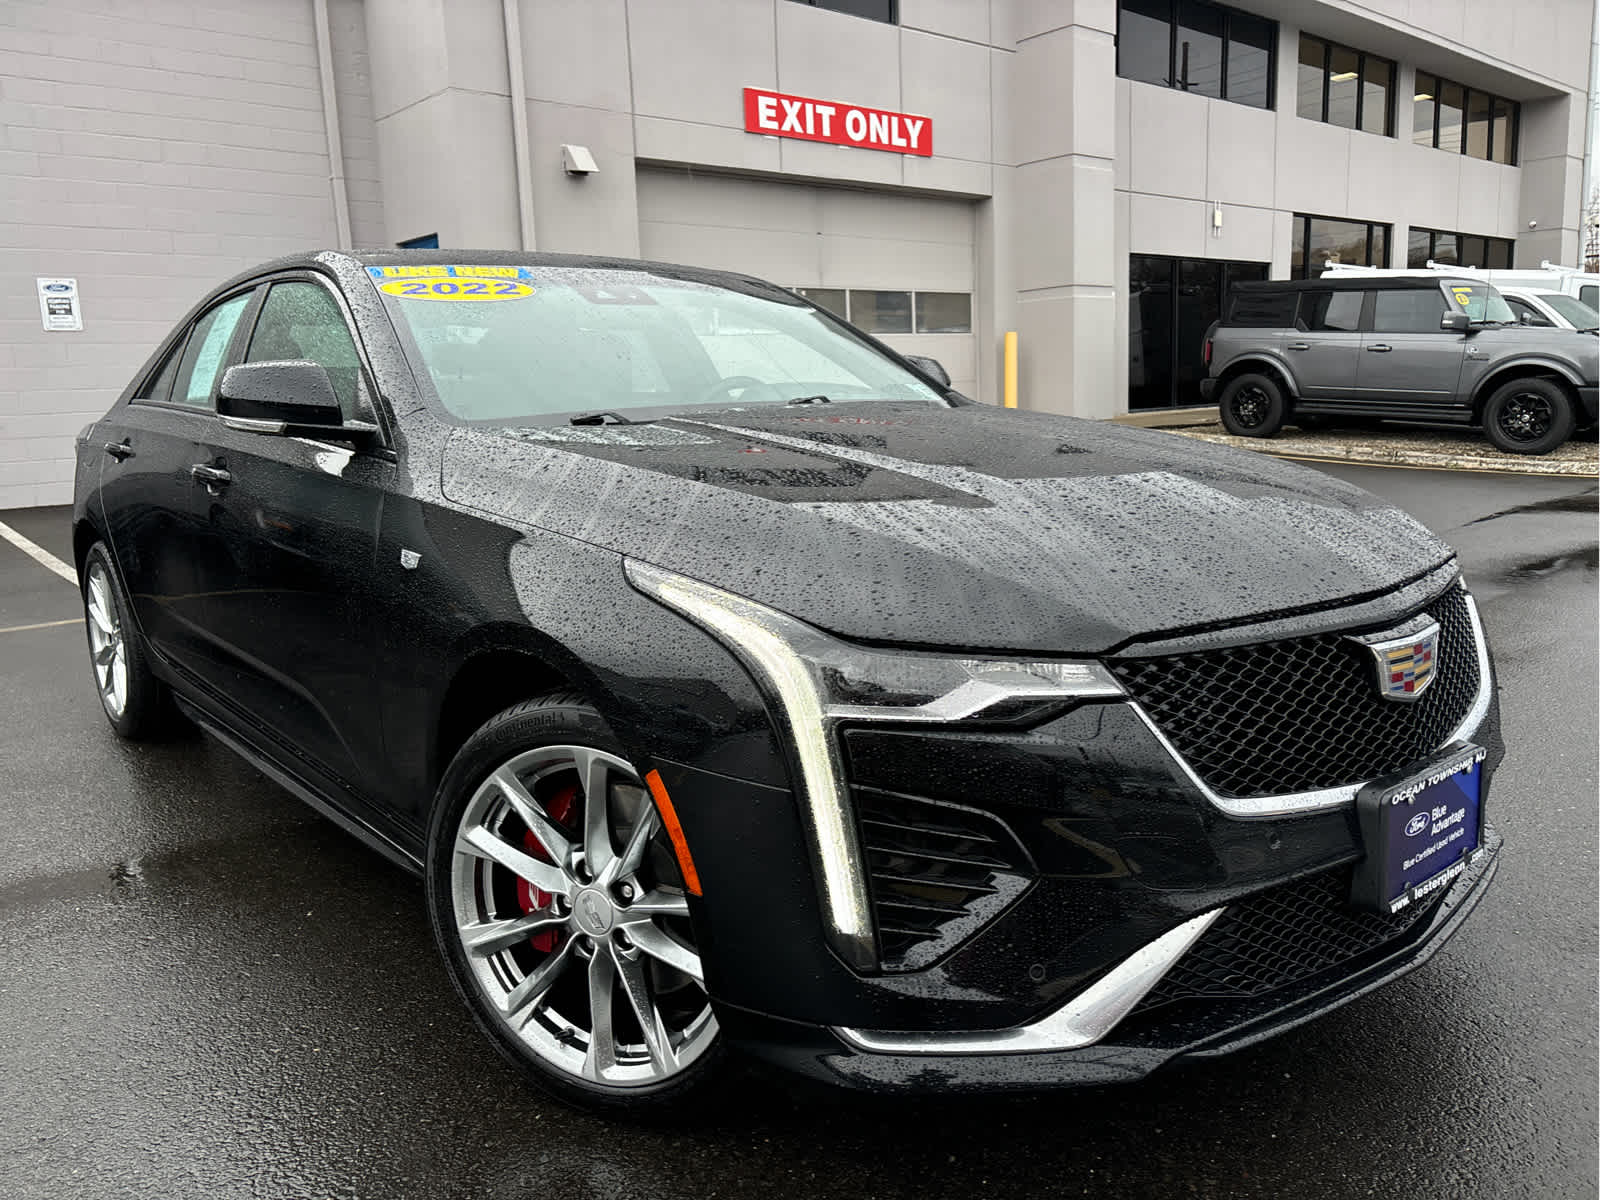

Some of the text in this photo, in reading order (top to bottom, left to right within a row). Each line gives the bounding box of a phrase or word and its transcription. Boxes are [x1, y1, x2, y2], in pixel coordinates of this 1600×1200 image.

[757, 95, 924, 149] EXIT ONLY
[454, 266, 519, 278] NEW
[401, 282, 521, 295] 2022
[495, 711, 557, 742] Continental
[1392, 780, 1426, 805] OCEAN
[1475, 749, 1487, 763] NJ
[1408, 815, 1427, 834] Ford
[1431, 805, 1447, 821] Blue
[1431, 807, 1465, 836] Advantage
[1403, 827, 1465, 870] Blue Certified Used Vehicle
